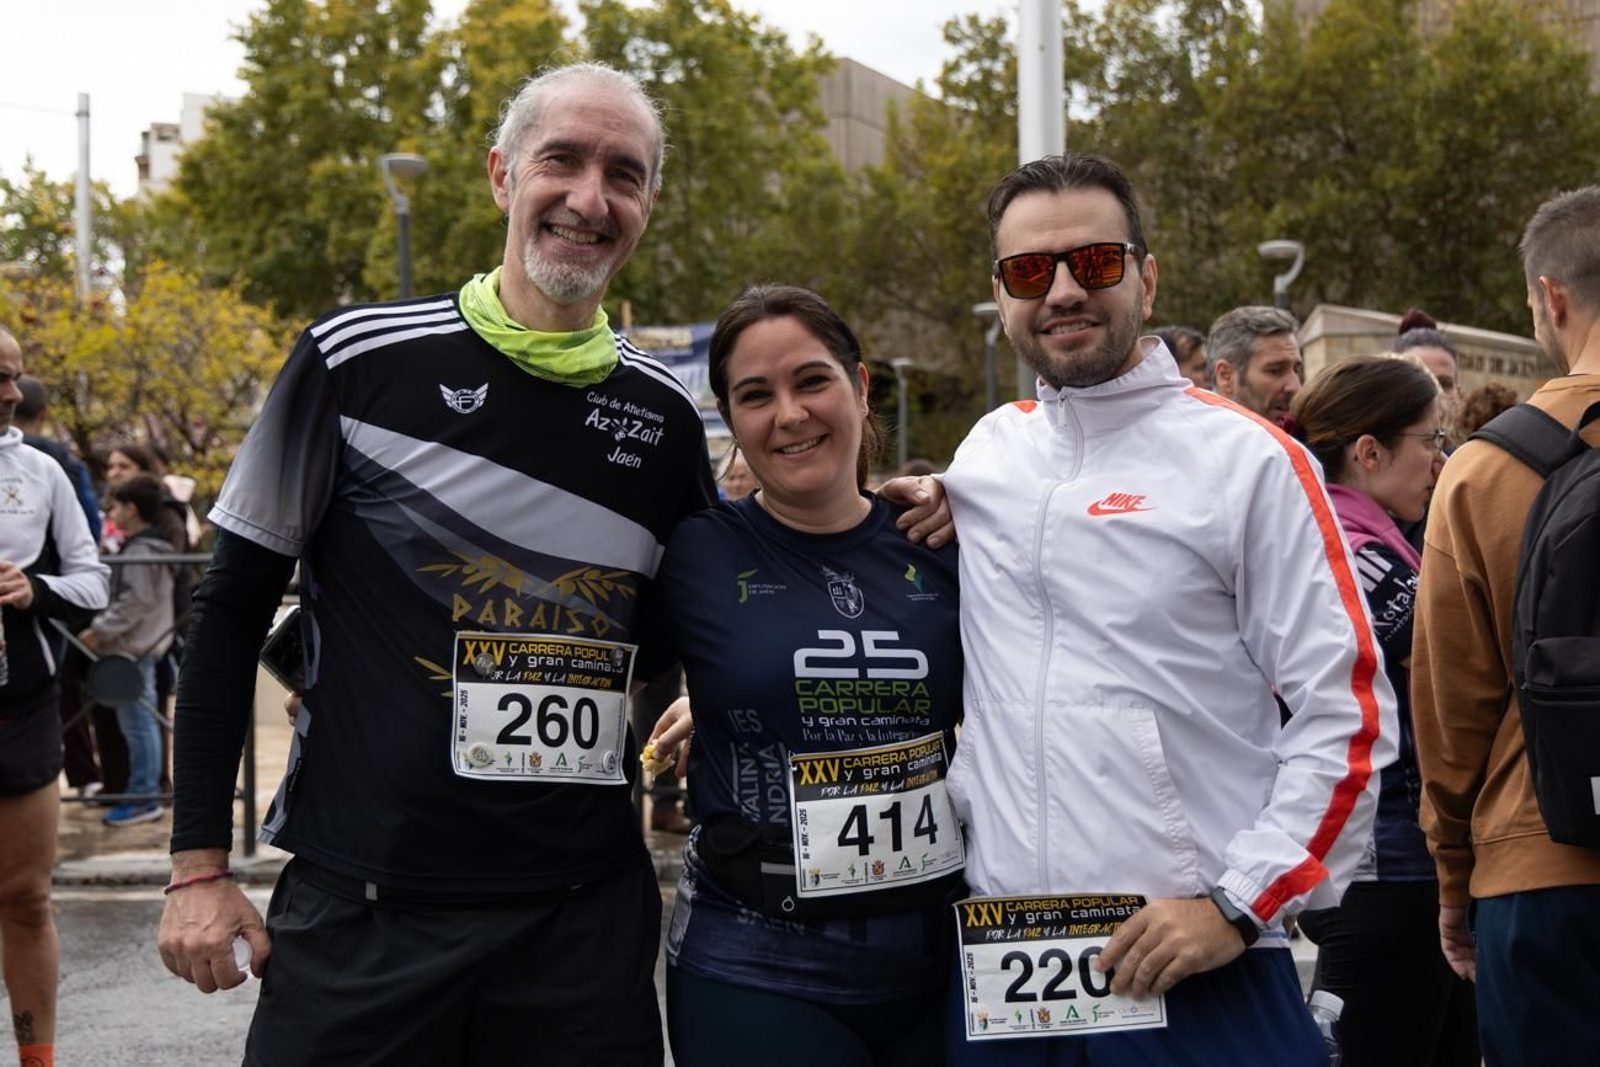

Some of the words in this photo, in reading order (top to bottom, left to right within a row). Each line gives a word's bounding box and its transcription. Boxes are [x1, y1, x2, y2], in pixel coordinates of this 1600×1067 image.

[586, 391, 608, 406] Club
[609, 398, 621, 410] de
[623, 402, 664, 423] Atletismo
[1101, 492, 1146, 508] NIKE
[508, 643, 572, 657] CARRERA
[574, 647, 609, 661] POPUL
[793, 630, 929, 680] 25
[508, 655, 519, 667] y
[528, 655, 564, 669] gran
[795, 680, 930, 697] CARRERA
[459, 689, 467, 707] 2025
[798, 698, 931, 715] POPULAR
[496, 693, 599, 750] 260
[728, 708, 763, 734] IES
[818, 716, 857, 727] gran
[861, 715, 930, 727] caminata
[799, 759, 839, 785] XXV
[843, 751, 908, 768] CARRERA
[909, 740, 941, 759] POPULAR
[844, 770, 853, 781] y
[863, 765, 900, 780] gran
[908, 753, 942, 771] caminata
[820, 785, 841, 797] POR
[843, 783, 858, 795] LA
[859, 782, 880, 794] PAZ
[890, 779, 905, 790] LA
[799, 808, 807, 826] 2025
[837, 794, 938, 857] 414
[964, 902, 1003, 927] XXV
[1005, 899, 1071, 912] CARRERA
[1072, 896, 1138, 908] POPULAR
[1007, 913, 1016, 925] y
[1025, 911, 1062, 924] gran
[986, 929, 1005, 940] POR
[1007, 928, 1022, 939] LA
[1023, 927, 1041, 938] PAZ
[1052, 925, 1067, 936] LA
[966, 952, 974, 969] 2025
[1000, 946, 1114, 1003] 220
